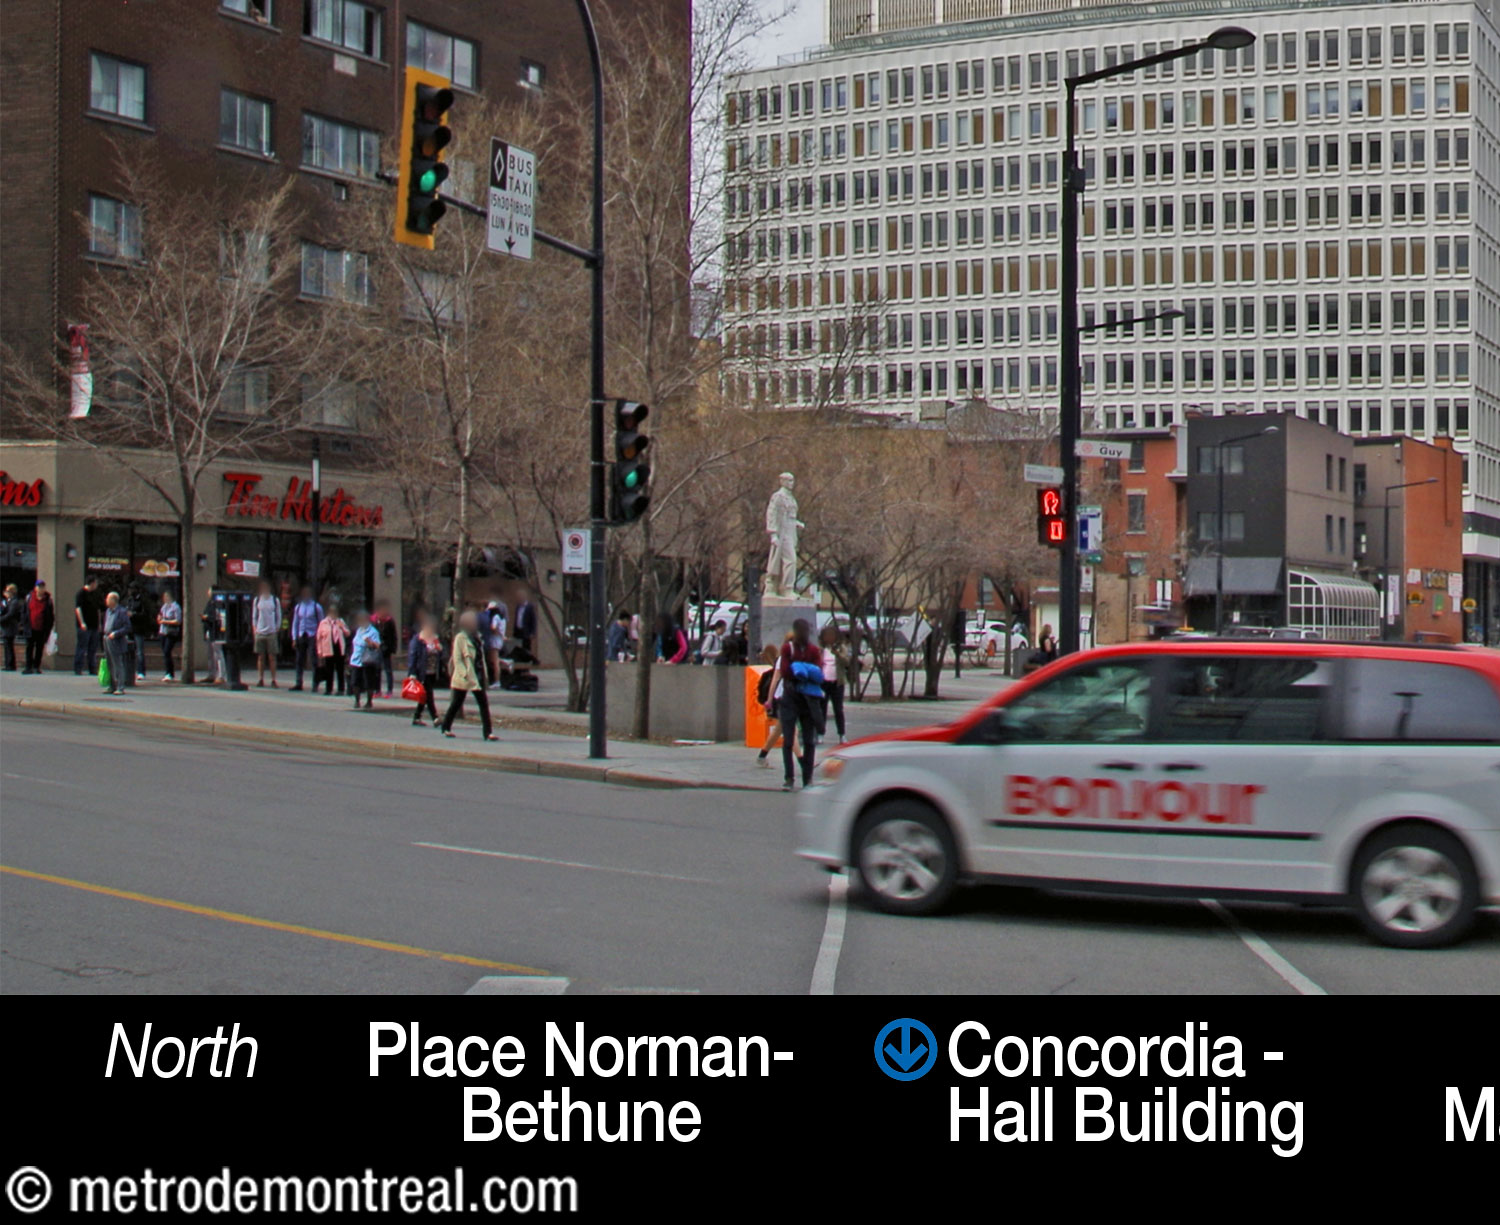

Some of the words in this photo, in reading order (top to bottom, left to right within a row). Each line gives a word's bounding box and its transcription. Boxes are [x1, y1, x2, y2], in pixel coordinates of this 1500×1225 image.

[508, 154, 532, 176] BUS
[508, 176, 532, 198] TAXI
[491, 214, 505, 230] LUN
[515, 221, 530, 237] VEN
[1099, 446, 1123, 457] Guy
[224, 473, 277, 517] Tim
